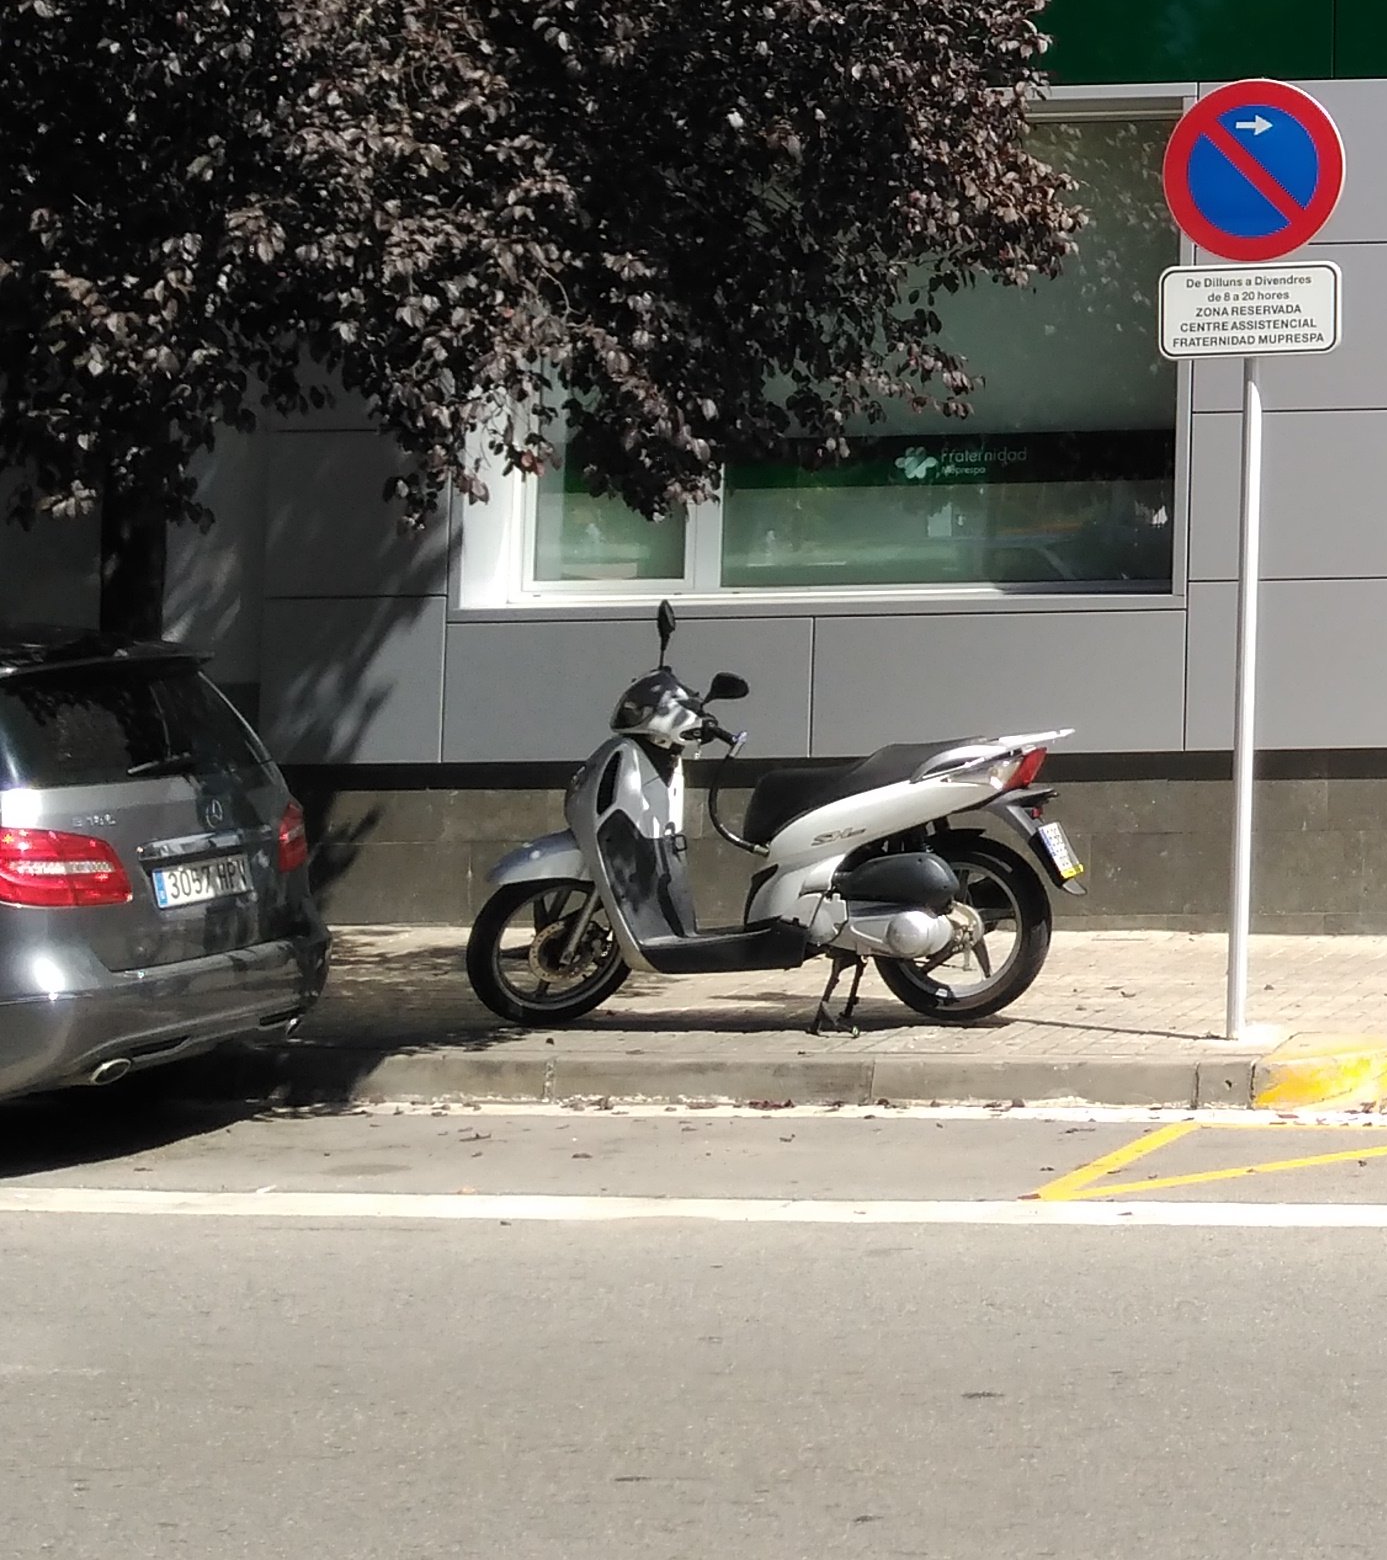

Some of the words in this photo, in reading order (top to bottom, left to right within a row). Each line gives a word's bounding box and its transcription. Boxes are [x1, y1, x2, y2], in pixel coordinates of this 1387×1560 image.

[1186, 278, 1201, 288] De
[1204, 277, 1243, 288] Dilluns
[1254, 275, 1312, 286] Divendres
[1208, 292, 1222, 303] de
[1223, 292, 1230, 302] 8
[1233, 294, 1240, 302] a
[1242, 291, 1255, 301] 20
[1257, 291, 1290, 301] hores
[1196, 306, 1229, 317] ZONA
[1231, 304, 1302, 316] RESERVADA
[1180, 321, 1229, 333] CENTRE
[1230, 318, 1317, 331] ASSISTENCIAL
[1173, 335, 1256, 348] FRATERNIDAD
[1258, 333, 1324, 345] MUPRESPA
[168, 865, 210, 899] 3057
[216, 859, 248, 891] HPV
